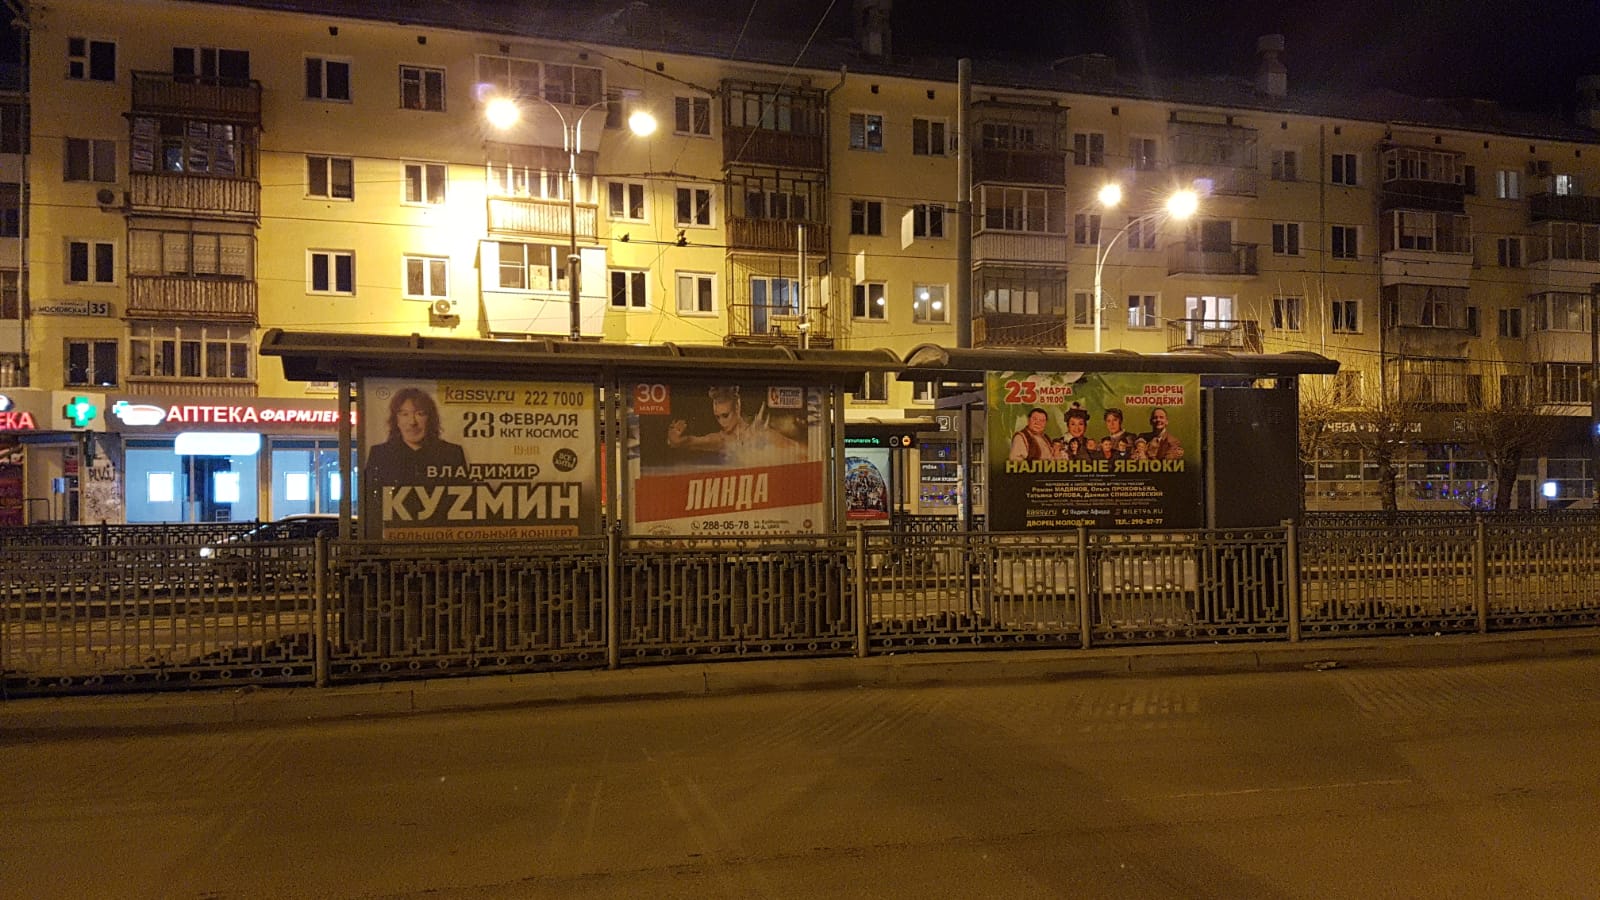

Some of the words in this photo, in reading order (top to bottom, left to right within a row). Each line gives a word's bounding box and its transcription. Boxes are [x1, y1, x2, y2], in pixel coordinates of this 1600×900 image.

[38, 305, 88, 313] МОСКОВСКАЯ
[92, 303, 106, 314] 35
[444, 386, 516, 404] kassy.ru
[636, 383, 666, 403] 30
[1005, 380, 1037, 404] 23
[1040, 387, 1072, 395] МАРТА
[1144, 385, 1183, 395] ДВОРЕЦ
[524, 391, 548, 406] 222
[553, 391, 584, 406] 7000
[1126, 395, 1183, 405] МОЛОДЁЖИ
[166, 405, 259, 423] АПТЕКА
[463, 411, 495, 438] 23
[500, 412, 578, 426] ФЕВРАЛЯ
[500, 428, 522, 439] ККТ
[526, 428, 579, 439] КОСМОС
[427, 465, 539, 479] ВЛАДИМИР
[1006, 460, 1109, 473] НАЛИВНЫЕ
[1114, 459, 1185, 473] ЯБЛОКИ
[685, 473, 769, 511] ЛИНДА
[702, 520, 750, 530] 288-05-78
[1026, 519, 1055, 527] ДВОРЕЦ
[388, 527, 455, 541] БОЛЬШОЙ
[458, 526, 518, 540] СОЛЬНЫЙ
[521, 526, 573, 539] КОНЦЕРТ
